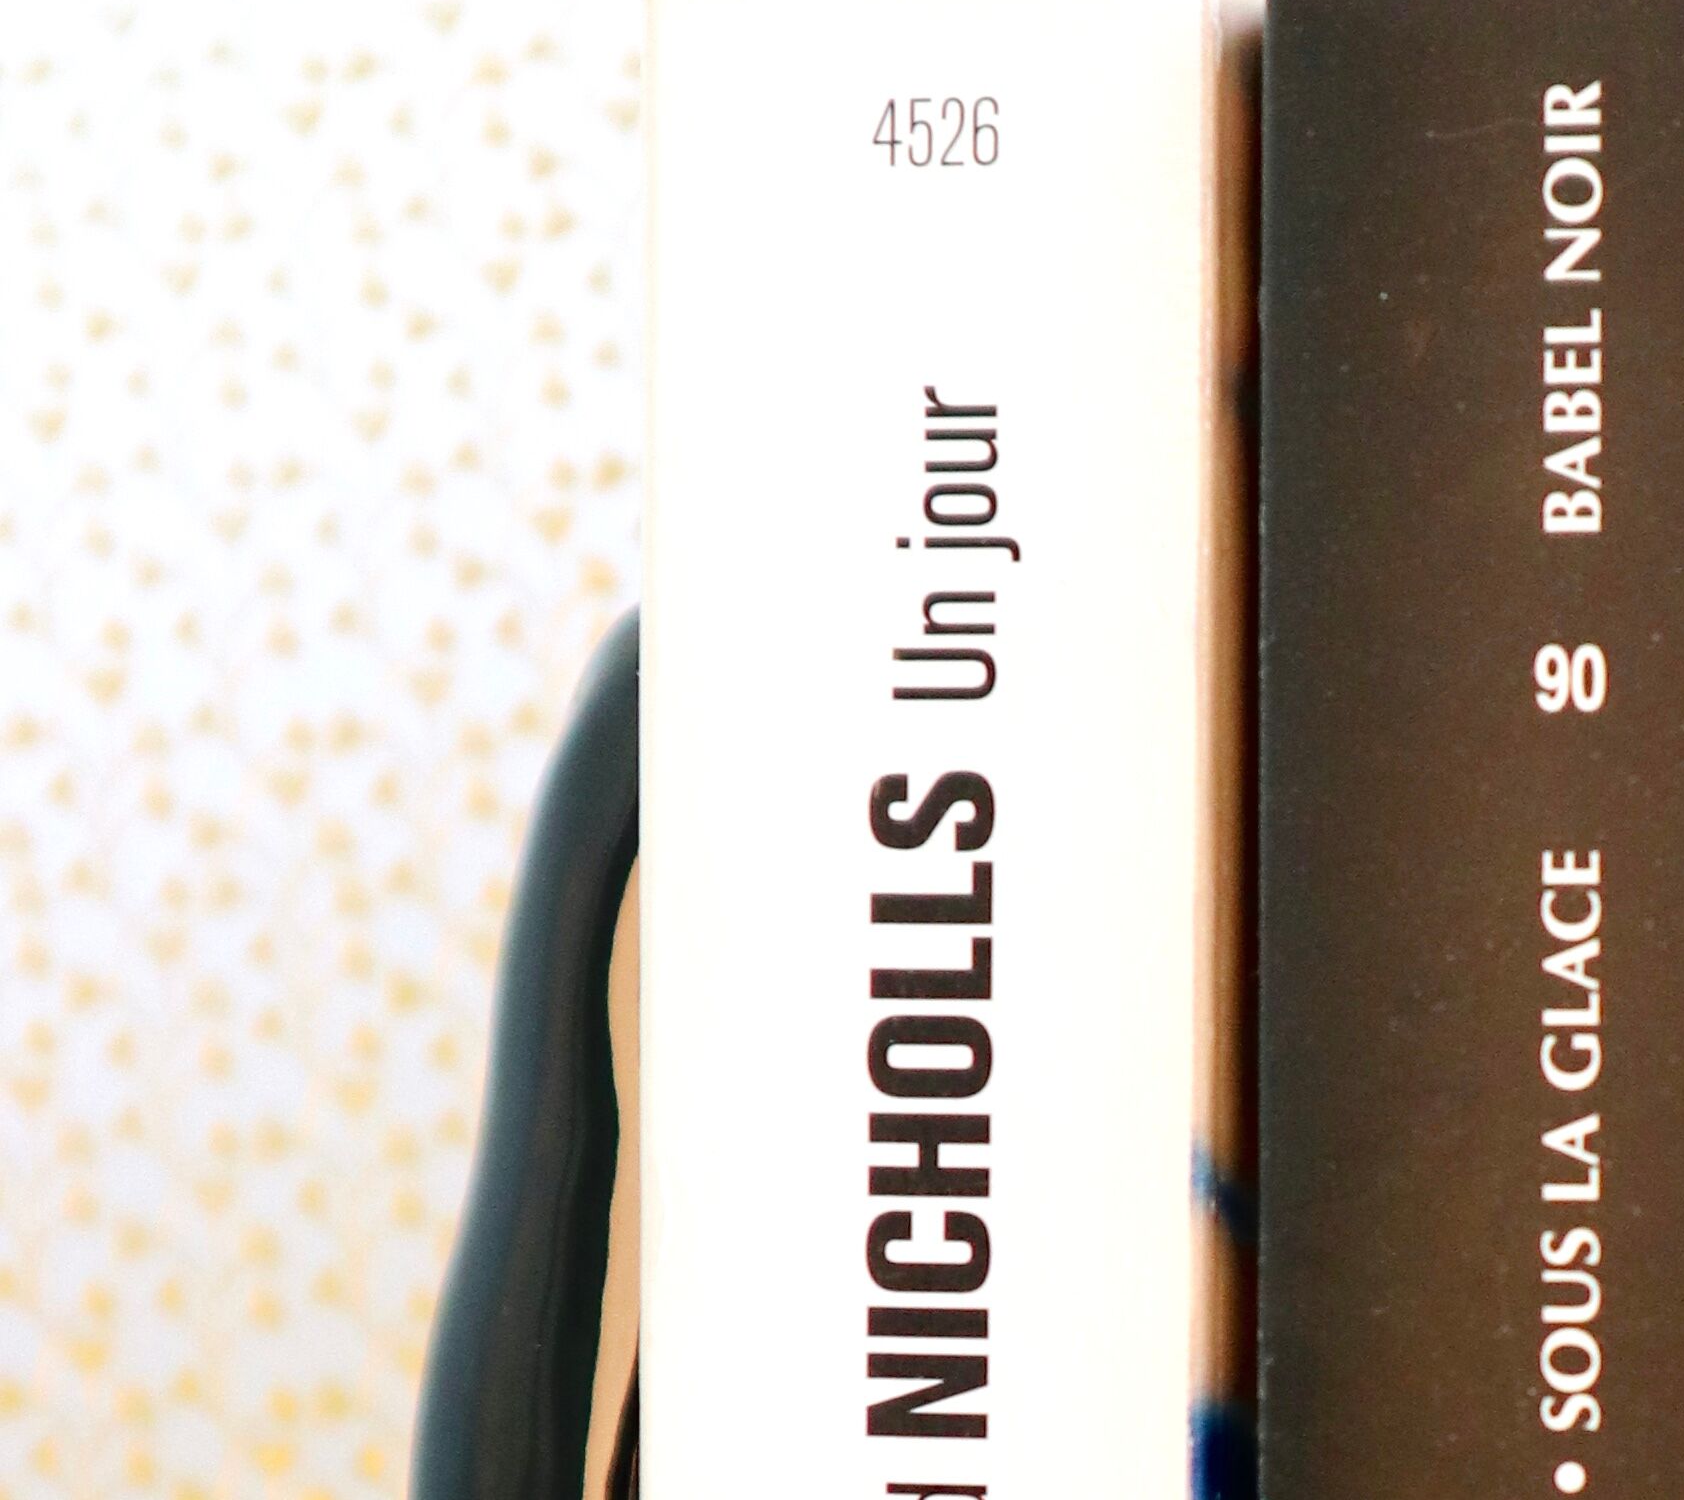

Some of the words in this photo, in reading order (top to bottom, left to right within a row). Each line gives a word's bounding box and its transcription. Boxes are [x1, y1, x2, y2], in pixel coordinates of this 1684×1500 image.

[872, 96, 999, 167] 4526
[1541, 80, 1604, 283] NOIR
[895, 385, 1022, 563] jour
[1542, 307, 1603, 534] BABEL
[891, 591, 998, 701] Un
[1533, 642, 1607, 715] 90
[1539, 849, 1602, 1092] GLACE
[865, 770, 997, 1440] NICHOLLS
[1540, 1112, 1601, 1202] LA
[1539, 1226, 1602, 1432] SOUS
